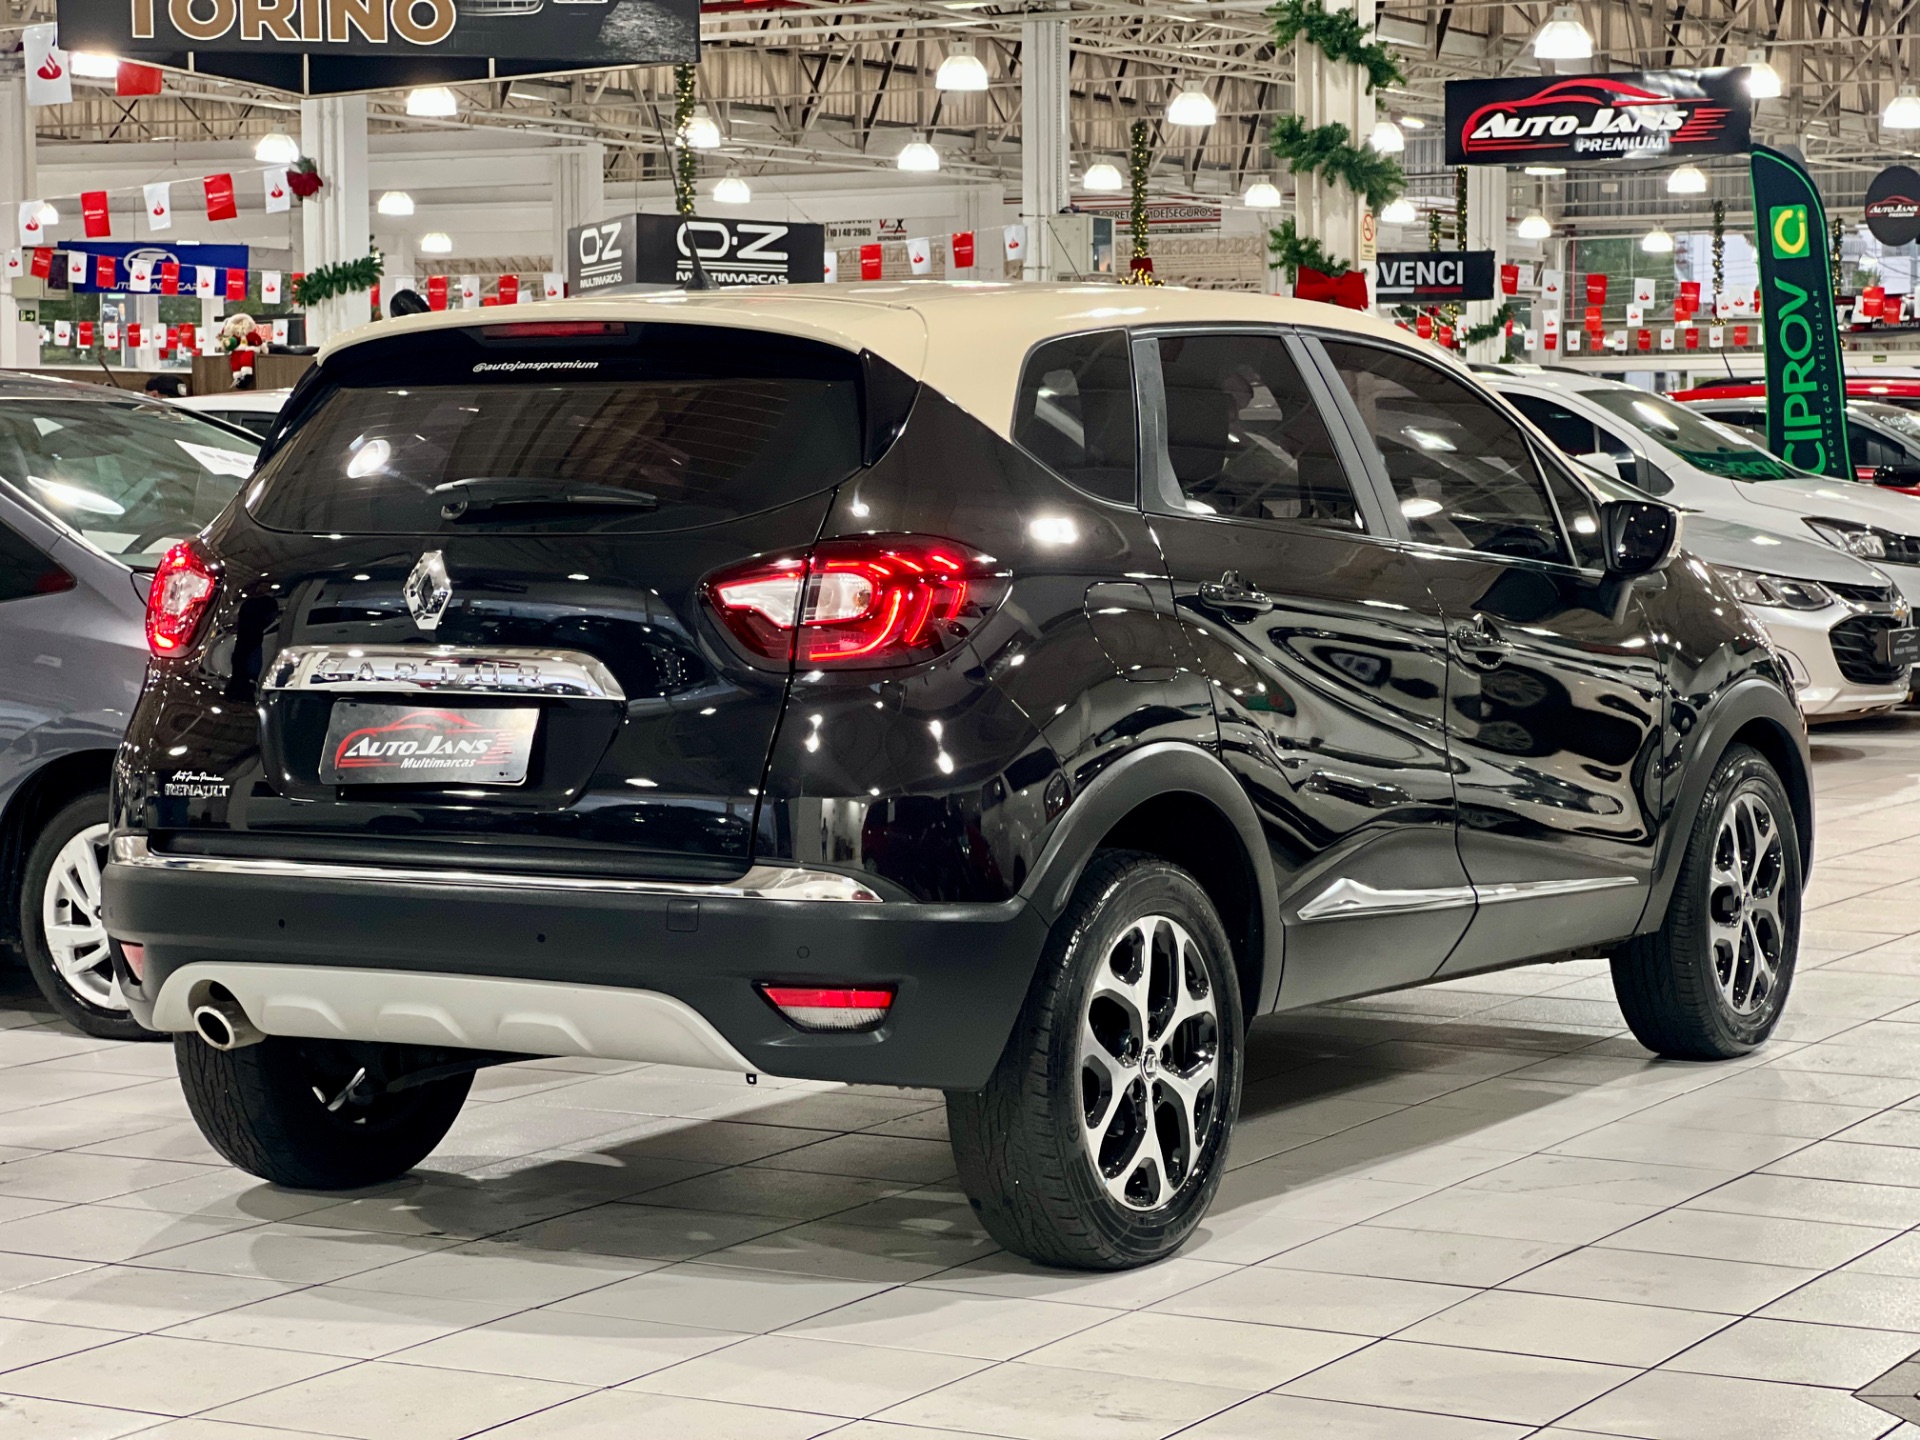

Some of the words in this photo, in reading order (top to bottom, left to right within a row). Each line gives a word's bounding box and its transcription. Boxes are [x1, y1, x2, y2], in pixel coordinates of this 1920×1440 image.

[1470, 112, 1579, 139] AUTO
[1574, 108, 1688, 135] JANS
[1578, 135, 1666, 152] PREMIUM
[1812, 290, 1827, 372] VEICULAR
[473, 360, 599, 372] @autojanspremium
[1773, 276, 1827, 476] CIPROV
[344, 736, 419, 757] AUTO
[414, 735, 493, 755] JANS
[400, 757, 476, 769] Multimarcas
[164, 783, 231, 797] RENAULT
